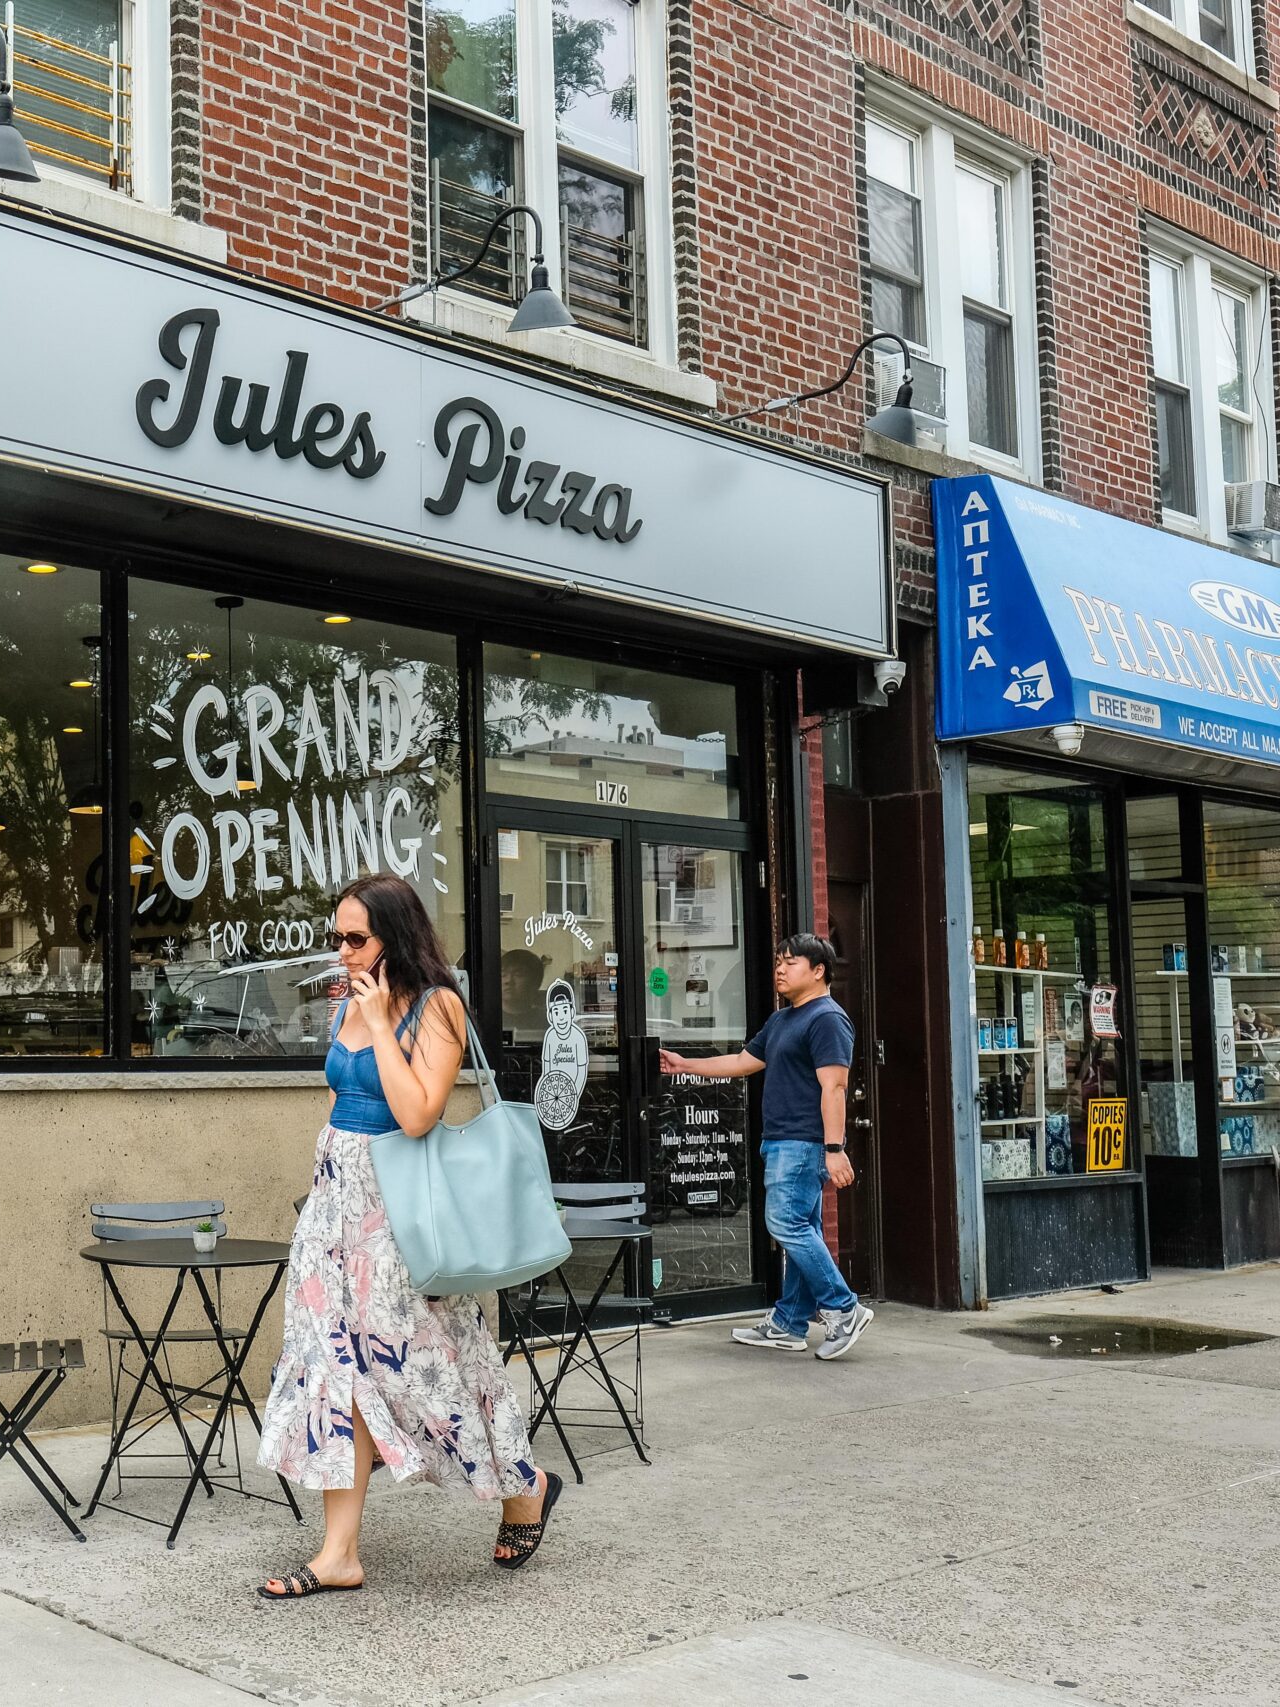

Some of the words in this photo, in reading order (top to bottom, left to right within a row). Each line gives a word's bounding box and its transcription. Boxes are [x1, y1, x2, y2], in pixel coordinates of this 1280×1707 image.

[136, 308, 387, 479] Jules
[424, 397, 643, 544] Pizza
[961, 491, 996, 670] АПТЕКА
[1217, 588, 1279, 634] GM
[1097, 696, 1128, 719] FREE
[1130, 703, 1151, 714] PICK-UP
[1131, 713, 1154, 724] DELIVERY
[183, 669, 412, 798] GRAND
[1178, 716, 1196, 737] WE
[1199, 721, 1238, 746] ACCEPT
[1242, 731, 1260, 750] ALL
[598, 783, 627, 805] 176
[162, 787, 423, 902] OPENING
[208, 920, 249, 959] FOR
[260, 919, 314, 953] GOOD
[524, 910, 559, 947] Jules
[562, 911, 594, 950] Pizza
[556, 1043, 573, 1054] Jules
[684, 1105, 719, 1124] Hours
[1093, 1105, 1124, 1124] COPIES
[661, 1133, 682, 1148] Monday
[685, 1131, 710, 1147] Saturday:
[712, 1131, 725, 1144] 11am
[729, 1131, 743, 1146] 10pm
[677, 1151, 699, 1167] Sunday:
[699, 1150, 713, 1166] 12pm
[716, 1150, 728, 1165] 9pm
[670, 1170, 736, 1185] thejulespizza.com
